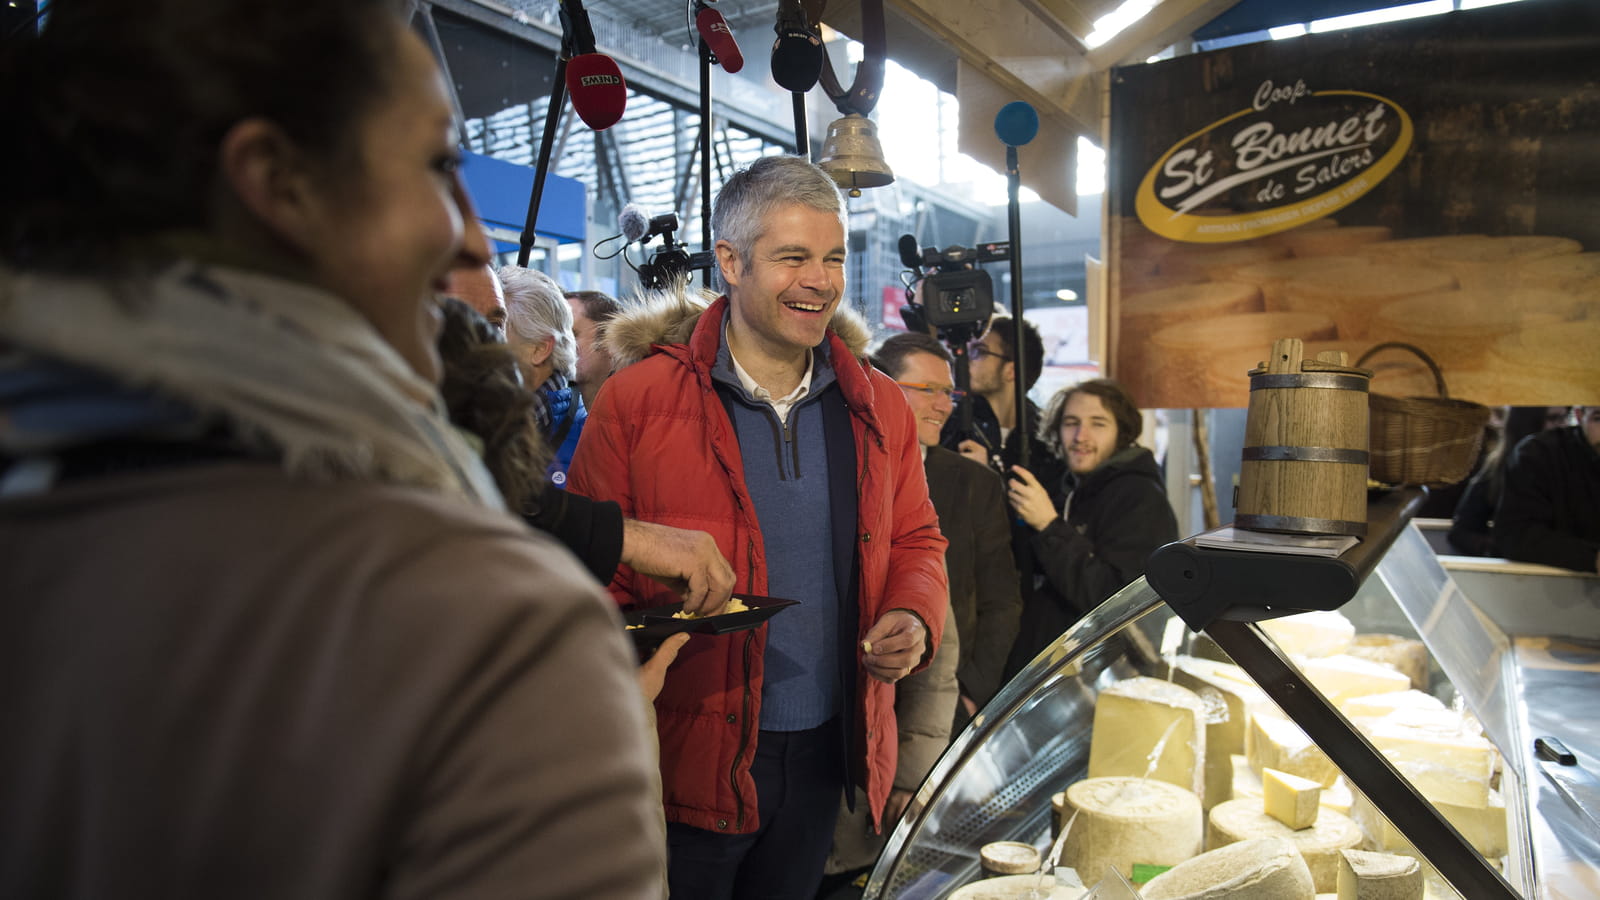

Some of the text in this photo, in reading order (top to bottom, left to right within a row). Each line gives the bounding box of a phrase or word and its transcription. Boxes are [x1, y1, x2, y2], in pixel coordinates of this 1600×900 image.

[1253, 79, 1311, 111] Coop.
[1160, 103, 1386, 199] St Bonnet
[1256, 149, 1373, 203] de Salers
